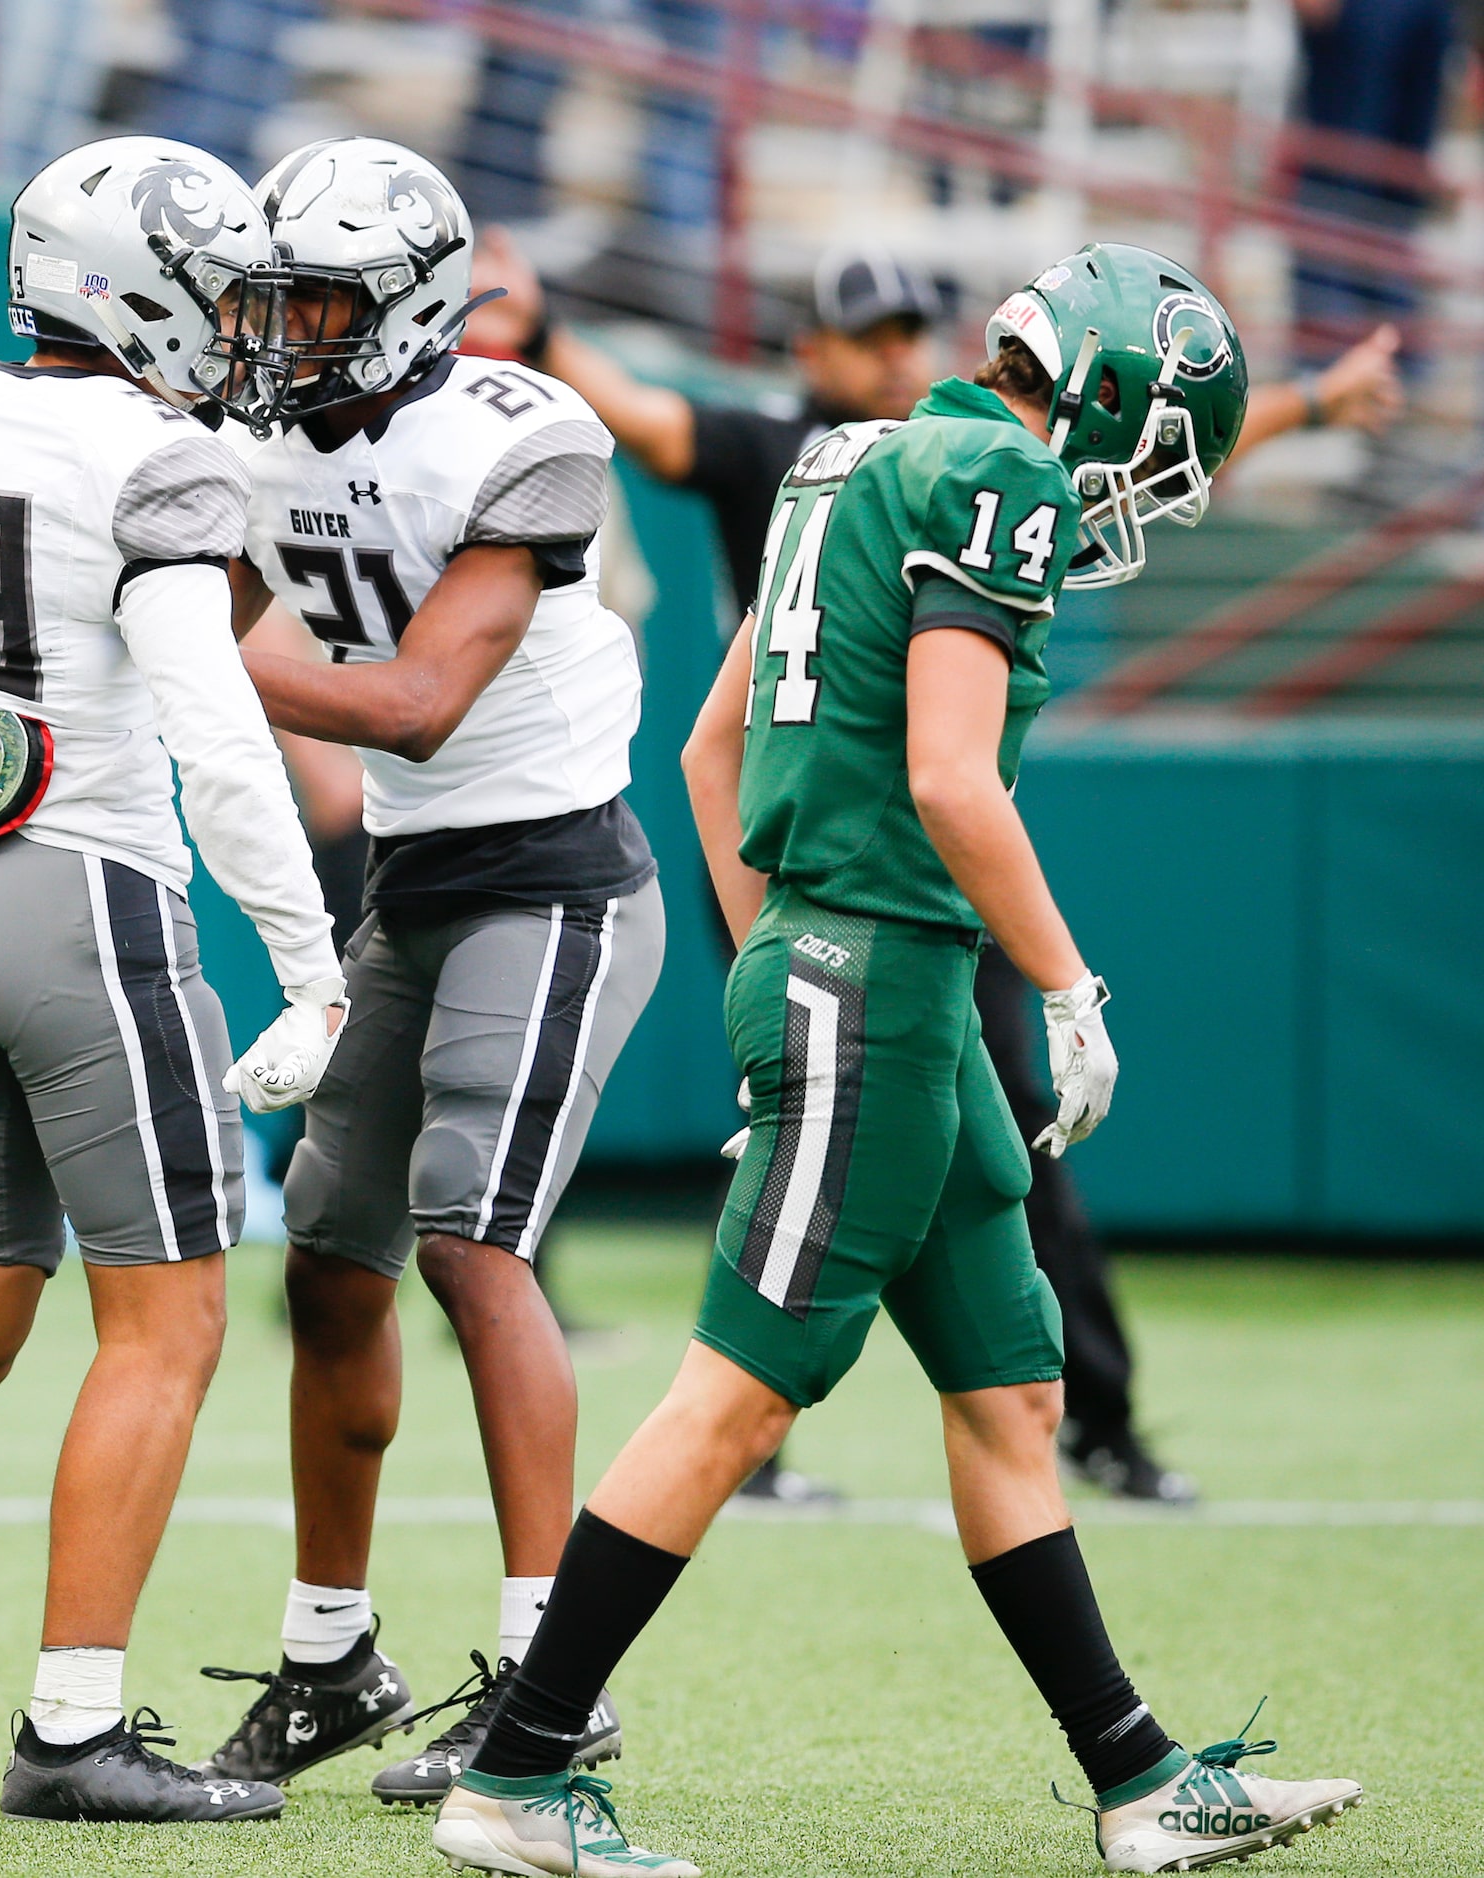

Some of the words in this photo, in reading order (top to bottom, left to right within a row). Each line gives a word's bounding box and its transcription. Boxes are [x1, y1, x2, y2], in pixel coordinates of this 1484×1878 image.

[84, 273, 109, 291] 100
[460, 369, 558, 423] 21
[289, 508, 352, 539] GUYER
[958, 490, 1058, 586] 14
[274, 541, 415, 664] 21
[744, 490, 834, 728] 14
[794, 933, 851, 968] COLTS
[1158, 1805, 1271, 1836] adidas
